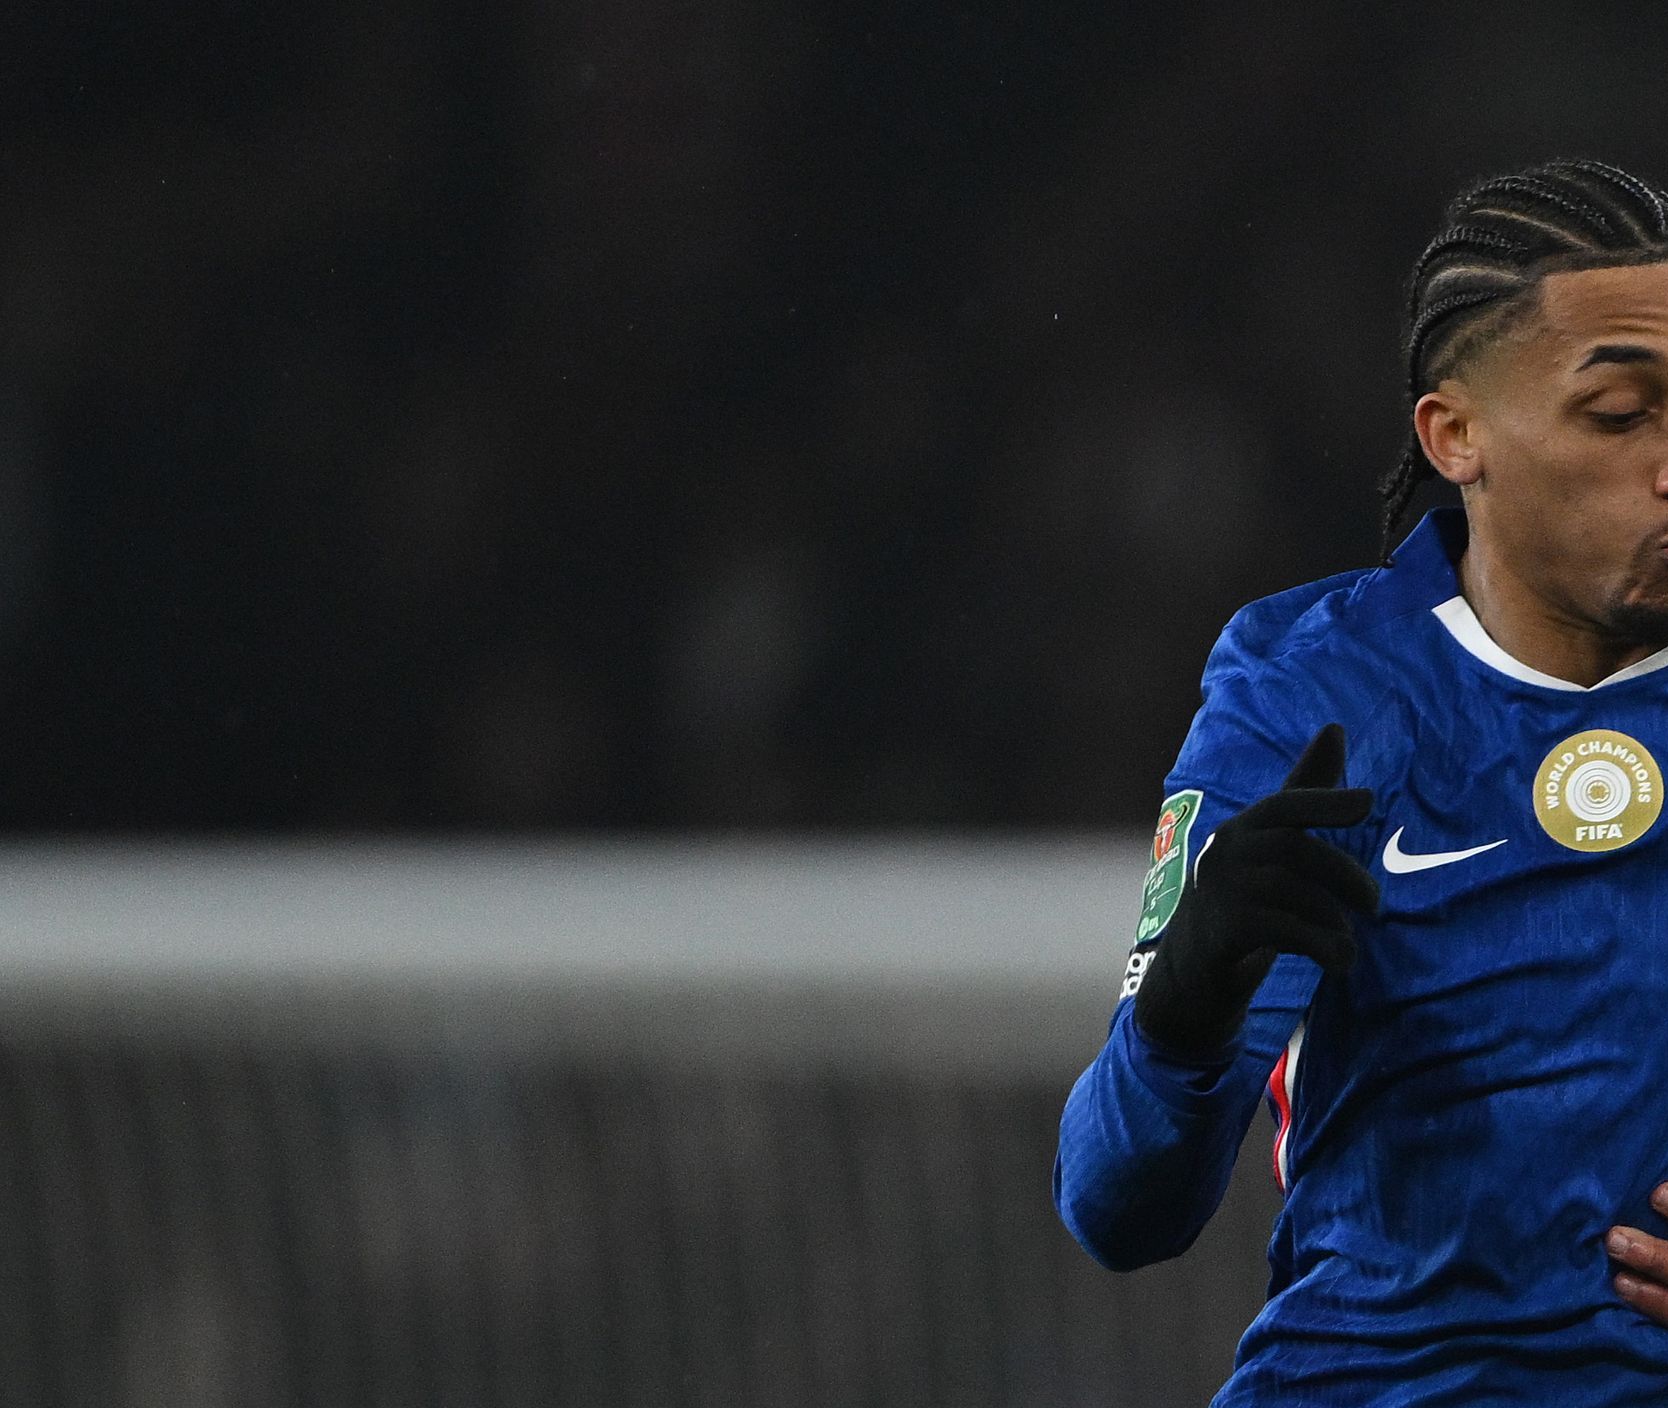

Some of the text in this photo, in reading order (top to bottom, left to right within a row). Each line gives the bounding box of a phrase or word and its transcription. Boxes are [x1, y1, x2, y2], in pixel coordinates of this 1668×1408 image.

[1545, 741, 1652, 810] WORLD CHAMPIONS
[1575, 823, 1623, 841] FIFA
